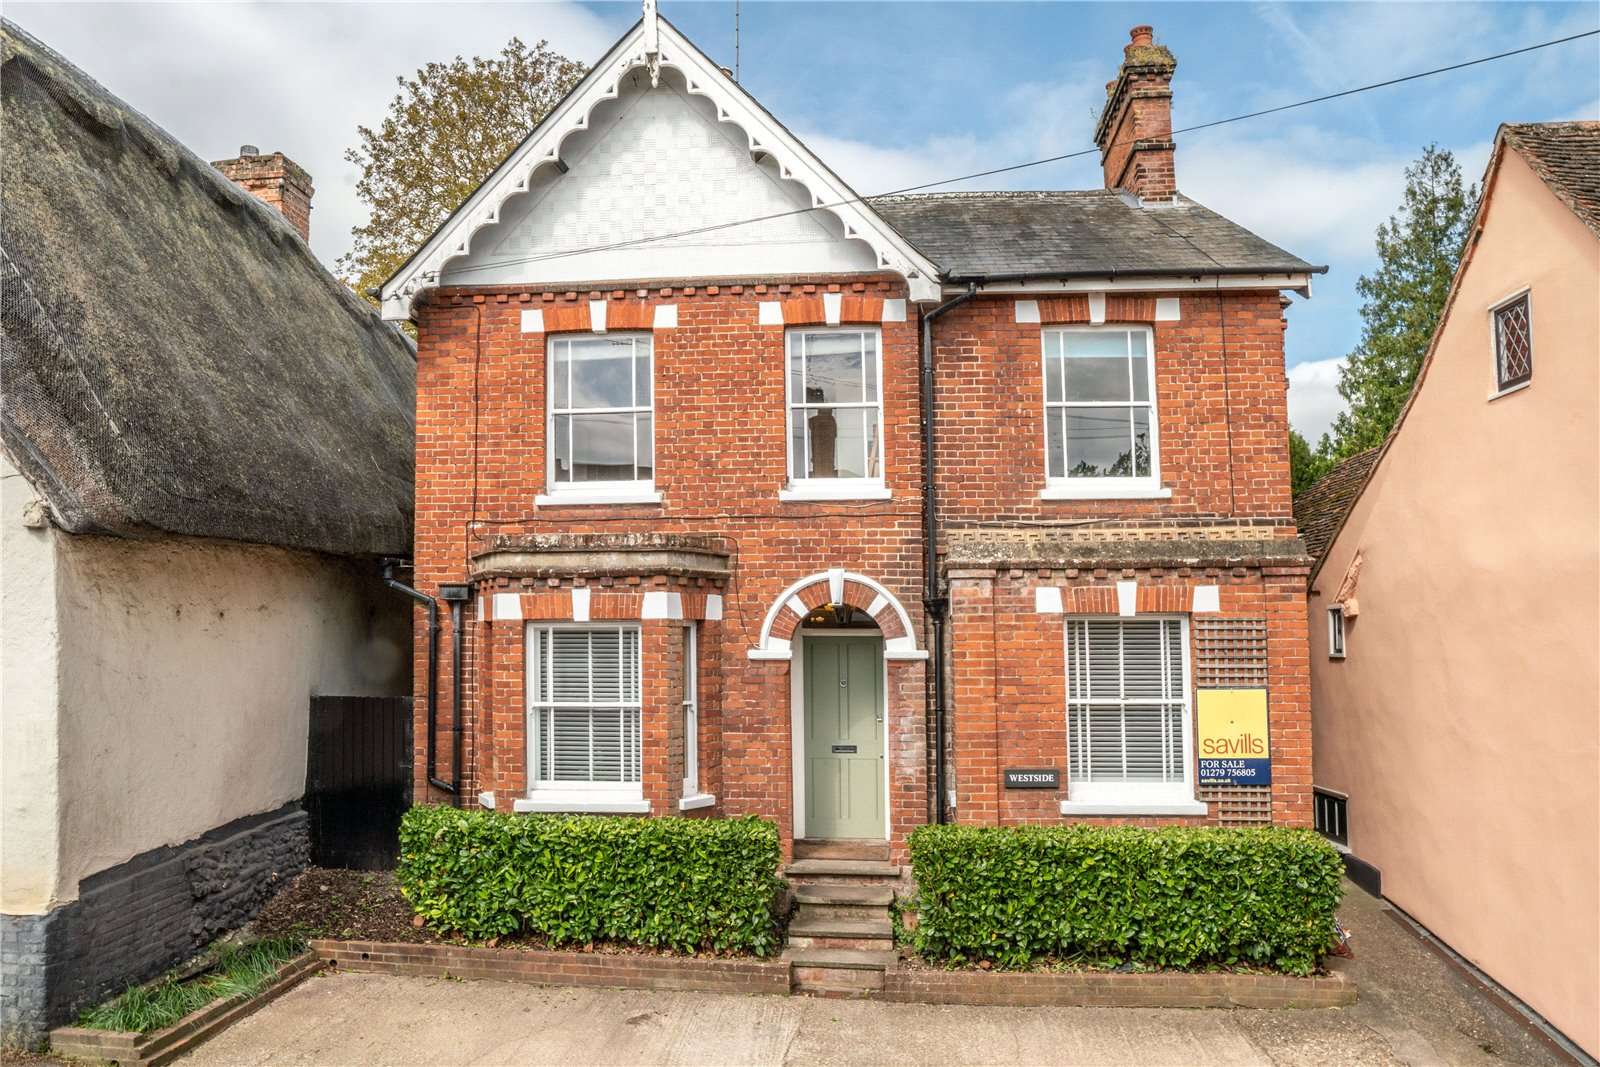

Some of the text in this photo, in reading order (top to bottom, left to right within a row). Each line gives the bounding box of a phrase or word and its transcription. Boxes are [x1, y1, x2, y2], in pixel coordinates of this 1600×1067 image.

[1203, 733, 1264, 754] savills
[1201, 760, 1245, 768] FOR SALE
[1201, 769, 1256, 777] 01279 756805
[1009, 774, 1054, 782] WESTSIDE
